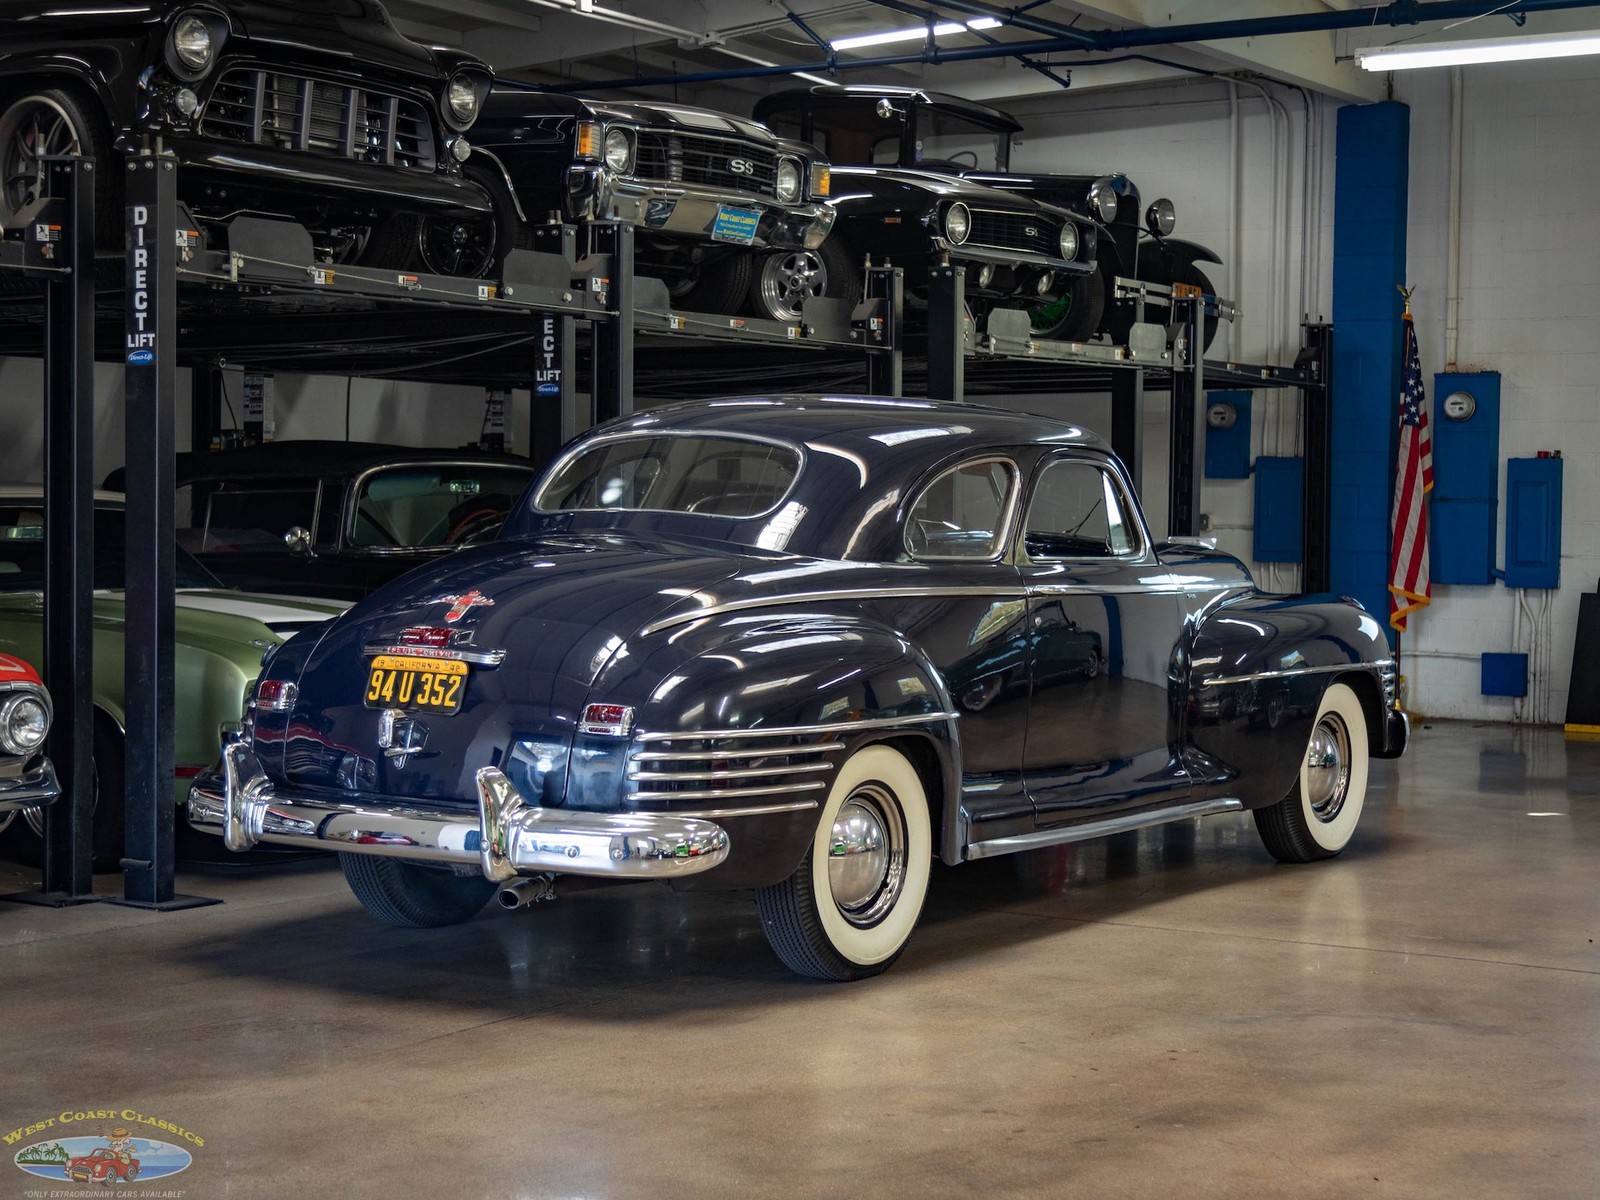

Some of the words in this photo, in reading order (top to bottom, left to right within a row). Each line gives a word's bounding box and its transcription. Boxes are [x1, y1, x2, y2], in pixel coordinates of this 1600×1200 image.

[731, 159, 754, 175] SS
[134, 206, 148, 331] DIRECT
[127, 333, 156, 348] LIFT
[536, 370, 561, 382] LIFT
[394, 661, 440, 670] CALIFORNIA
[368, 670, 397, 702] 94
[399, 672, 415, 703] U
[417, 673, 462, 707] 352
